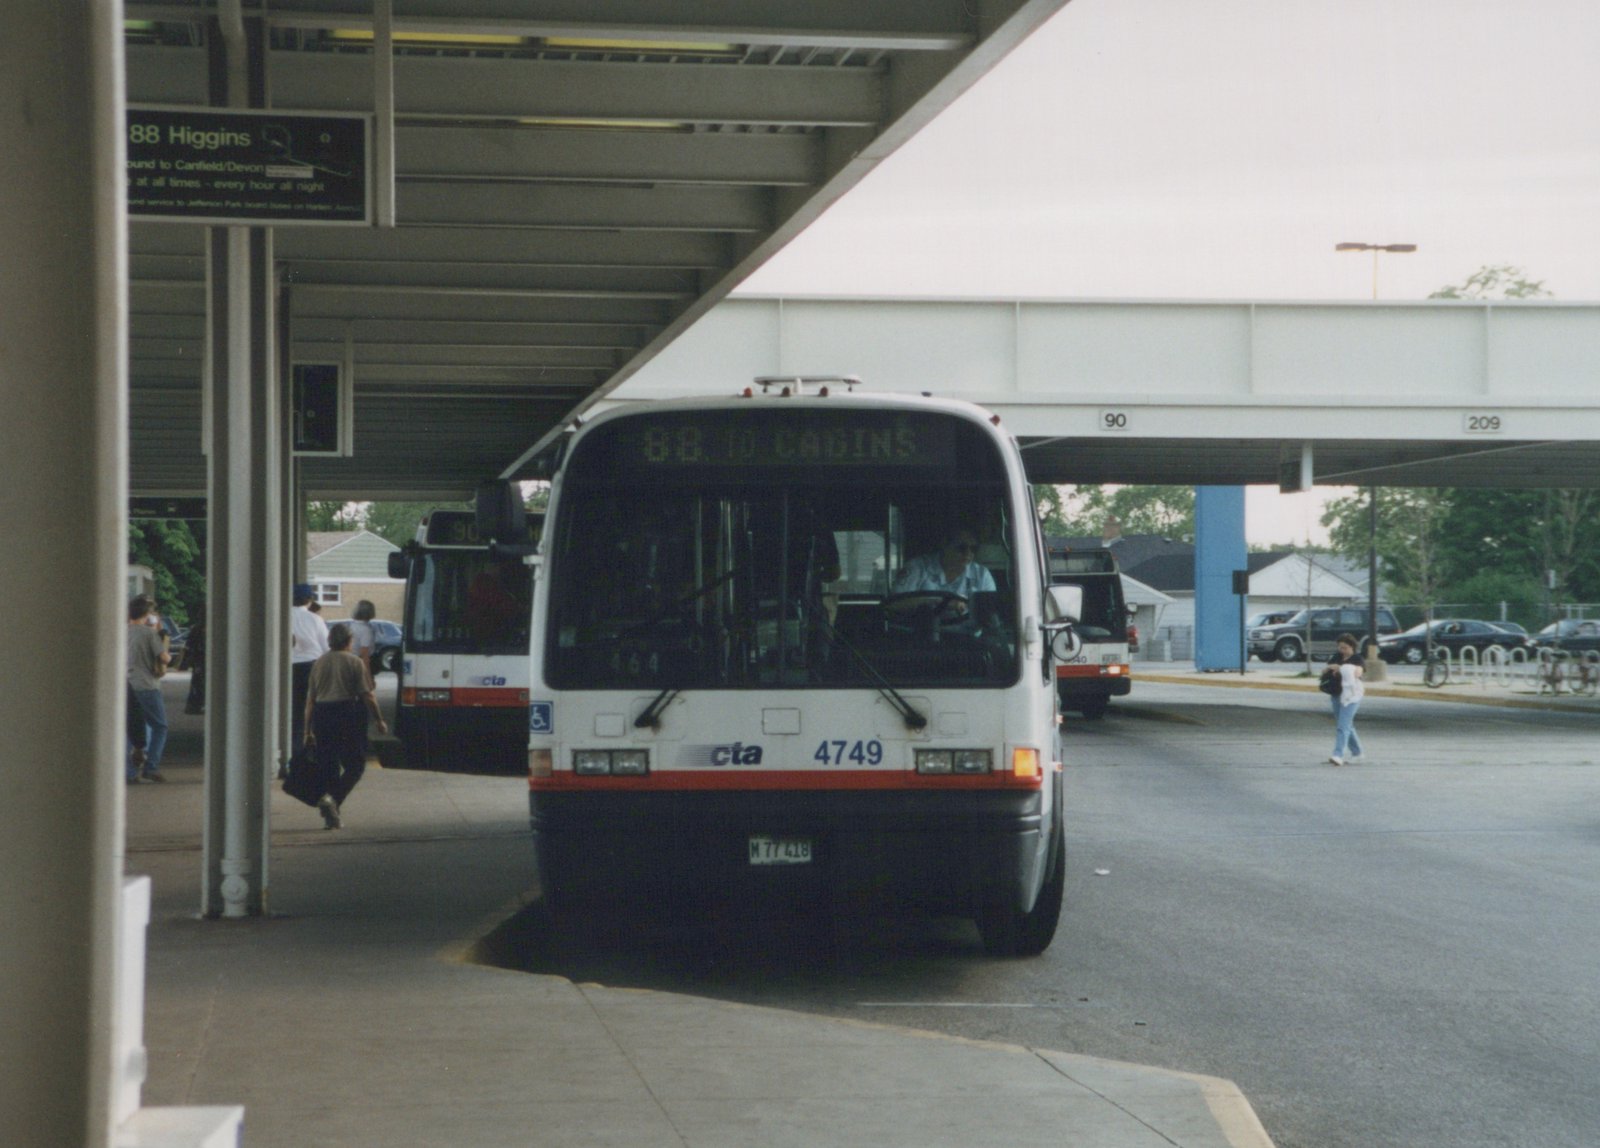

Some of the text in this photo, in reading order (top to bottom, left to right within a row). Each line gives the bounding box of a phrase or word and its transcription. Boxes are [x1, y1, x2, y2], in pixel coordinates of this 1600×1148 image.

[130, 124, 250, 150] 88 Higgins
[160, 161, 172, 169] to
[175, 160, 264, 172] Canfield/Devon
[136, 177, 148, 186] at
[153, 177, 165, 186] all
[169, 178, 201, 188] times
[214, 181, 244, 191] every
[250, 181, 274, 190] hour
[297, 183, 325, 193] night
[1105, 413, 1126, 428] 90
[1469, 416, 1501, 430] 209
[482, 676, 506, 686] cta
[710, 742, 763, 766] cta
[814, 740, 883, 765] 4749
